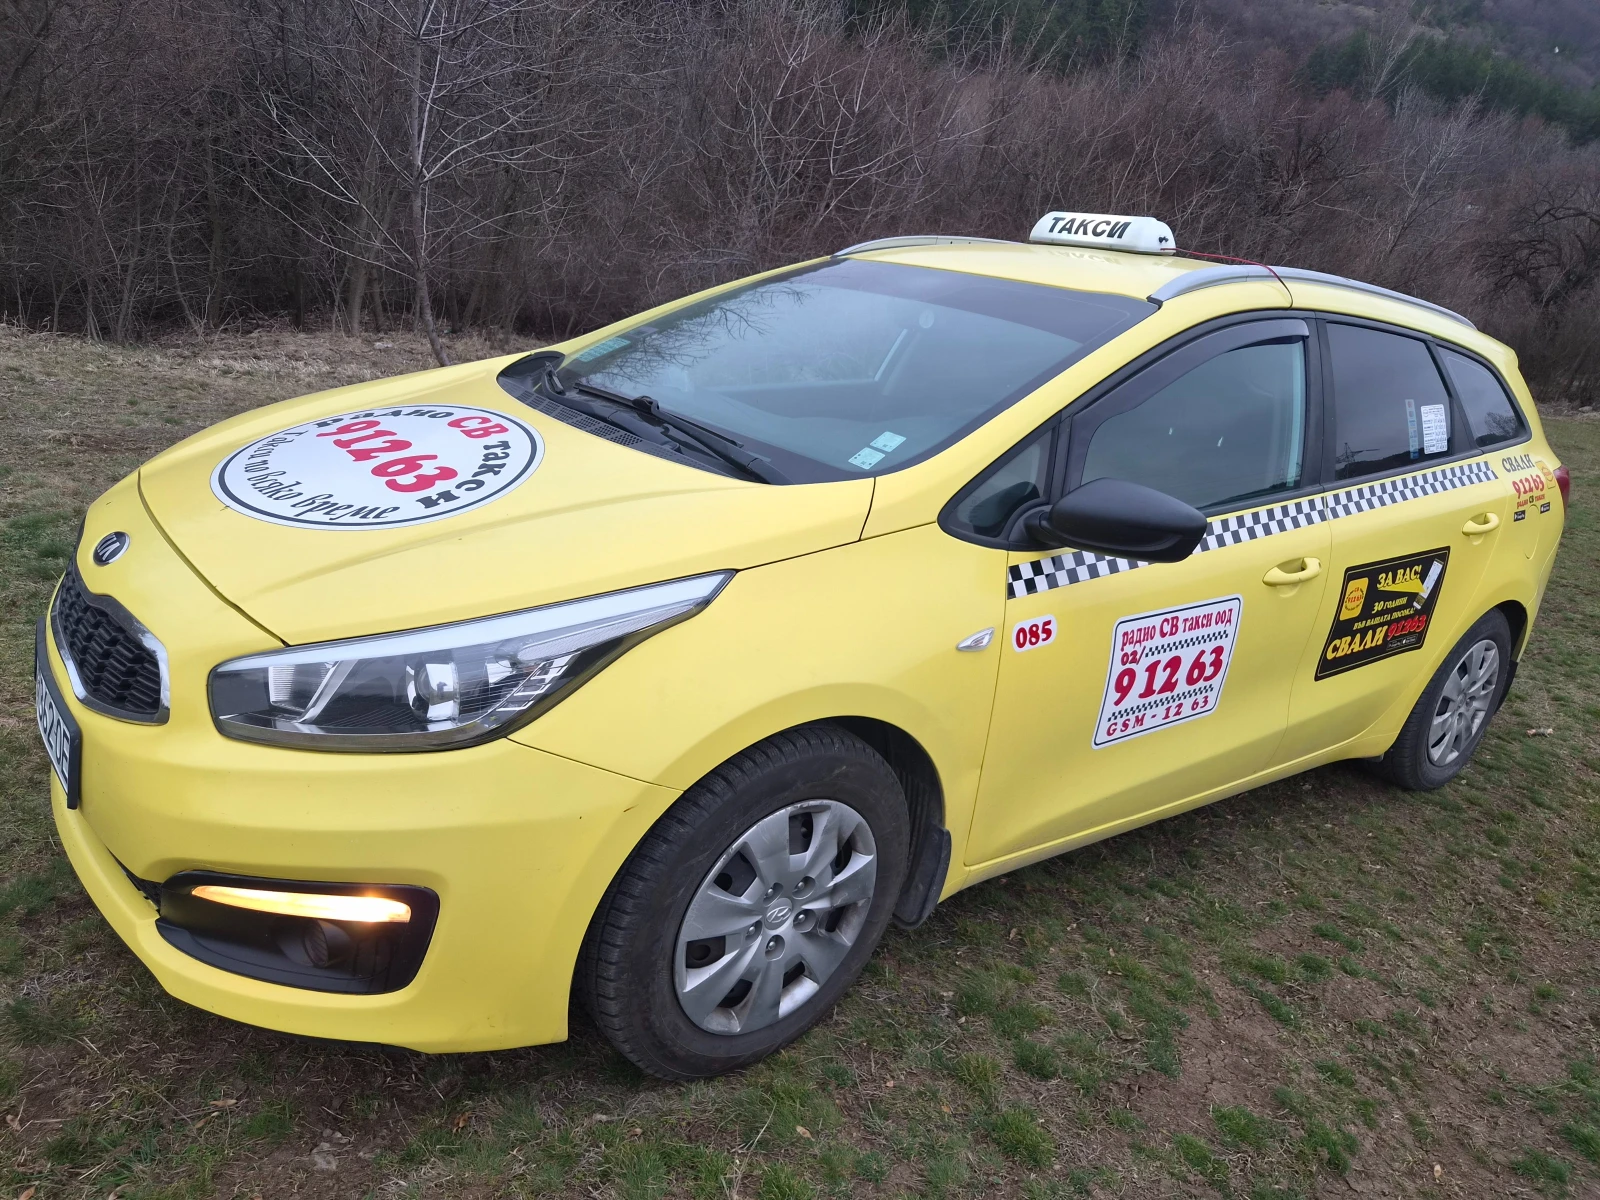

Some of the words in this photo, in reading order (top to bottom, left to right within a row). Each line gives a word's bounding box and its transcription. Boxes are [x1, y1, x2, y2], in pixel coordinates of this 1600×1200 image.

[1048, 216, 1132, 239] ТАКСИ
[415, 440, 511, 509] такси
[1501, 454, 1536, 473] СВАЛИ
[290, 493, 401, 521] време
[1376, 572, 1393, 589] ЗА
[1394, 564, 1422, 585] ВАС!
[1371, 600, 1384, 614] 30
[1015, 619, 1053, 649] 085
[1121, 624, 1156, 652] радио
[1159, 615, 1179, 638] СВ
[1182, 612, 1213, 633] такси
[1215, 608, 1233, 628] оод
[1326, 625, 1388, 660] СВАЛИ
